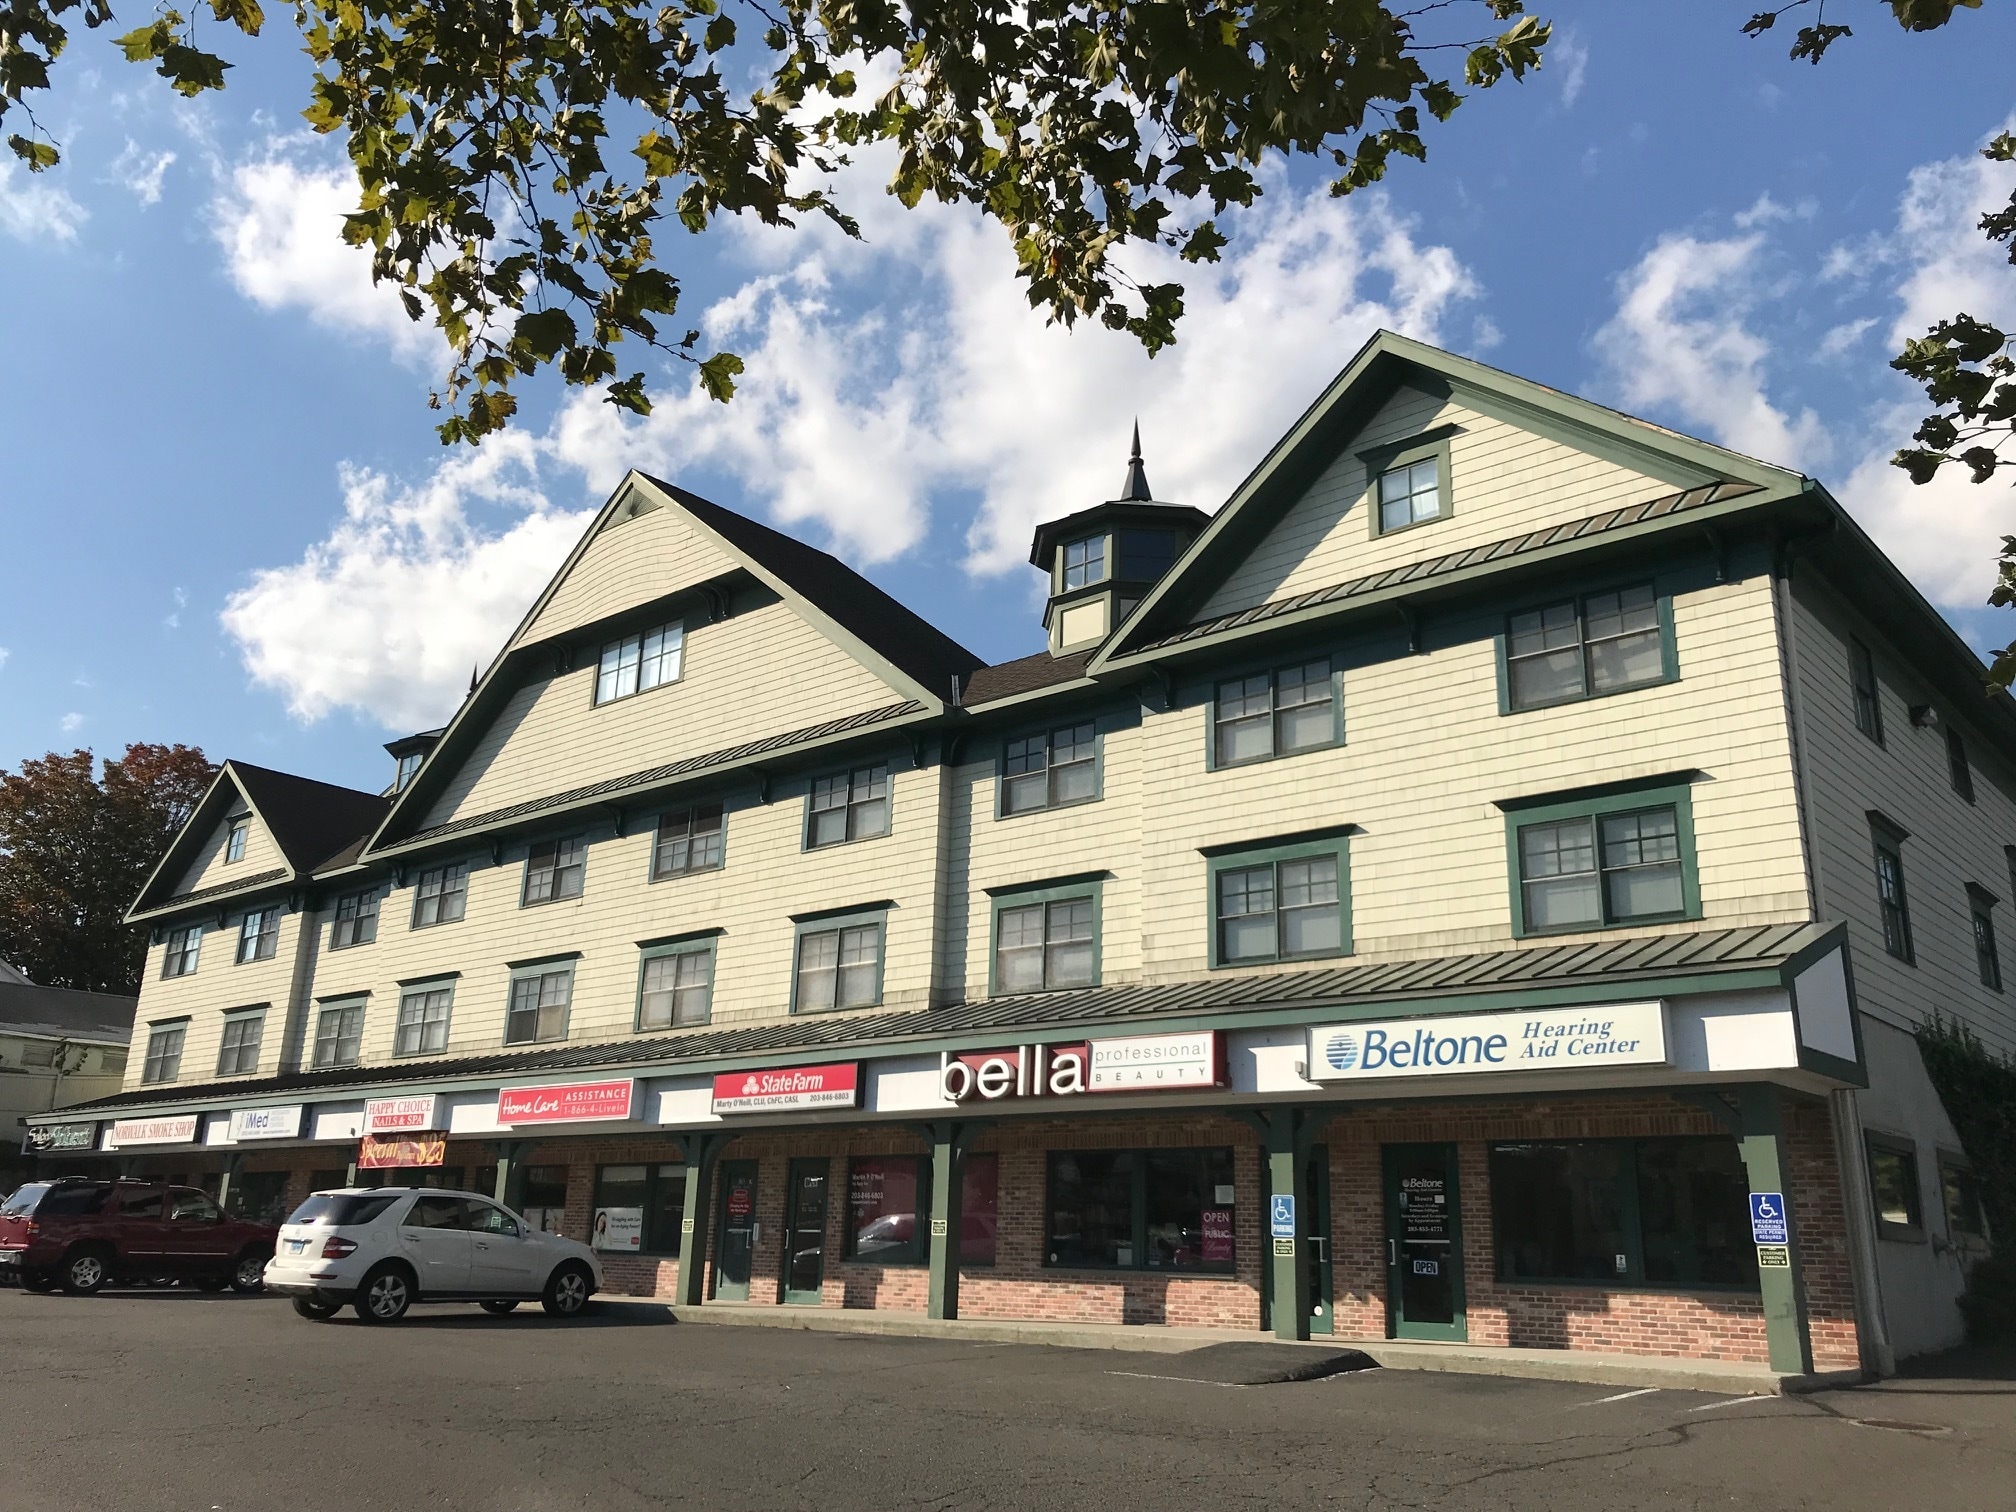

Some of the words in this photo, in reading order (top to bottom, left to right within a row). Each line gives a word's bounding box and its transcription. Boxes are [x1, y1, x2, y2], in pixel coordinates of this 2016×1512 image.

[1522, 1018, 1614, 1040] Hearing
[1095, 1042, 1206, 1066] professional
[1359, 1028, 1508, 1071] Beltone
[1519, 1040, 1558, 1060] Aid
[1567, 1036, 1641, 1056] Center
[939, 1044, 1086, 1101] bella
[1095, 1067, 1206, 1083] BEAUTY
[565, 1088, 627, 1102] ASSISTANCE
[716, 1099, 733, 1109] Marty
[733, 1098, 753, 1108] O'Neill,
[753, 1096, 766, 1107] CLU,
[767, 1095, 784, 1106] ChFC,
[809, 1092, 849, 1103] 203-846-6803
[368, 1102, 396, 1115] HAPPY
[397, 1099, 432, 1113] CHOICE
[502, 1096, 532, 1115] Home
[533, 1094, 559, 1114] Care
[564, 1102, 625, 1115] 1-866-4-LiveIn
[245, 1111, 270, 1129] iMed
[373, 1116, 398, 1127] NAILS
[398, 1116, 406, 1125] &
[407, 1114, 423, 1125] SPA
[113, 1124, 148, 1140] NORWALK
[148, 1122, 174, 1139] SMOKE
[174, 1120, 195, 1137] SHOP
[1410, 1178, 1443, 1188] Beltone
[1203, 1212, 1230, 1222] OPEN
[1415, 1261, 1436, 1274] OPEN
